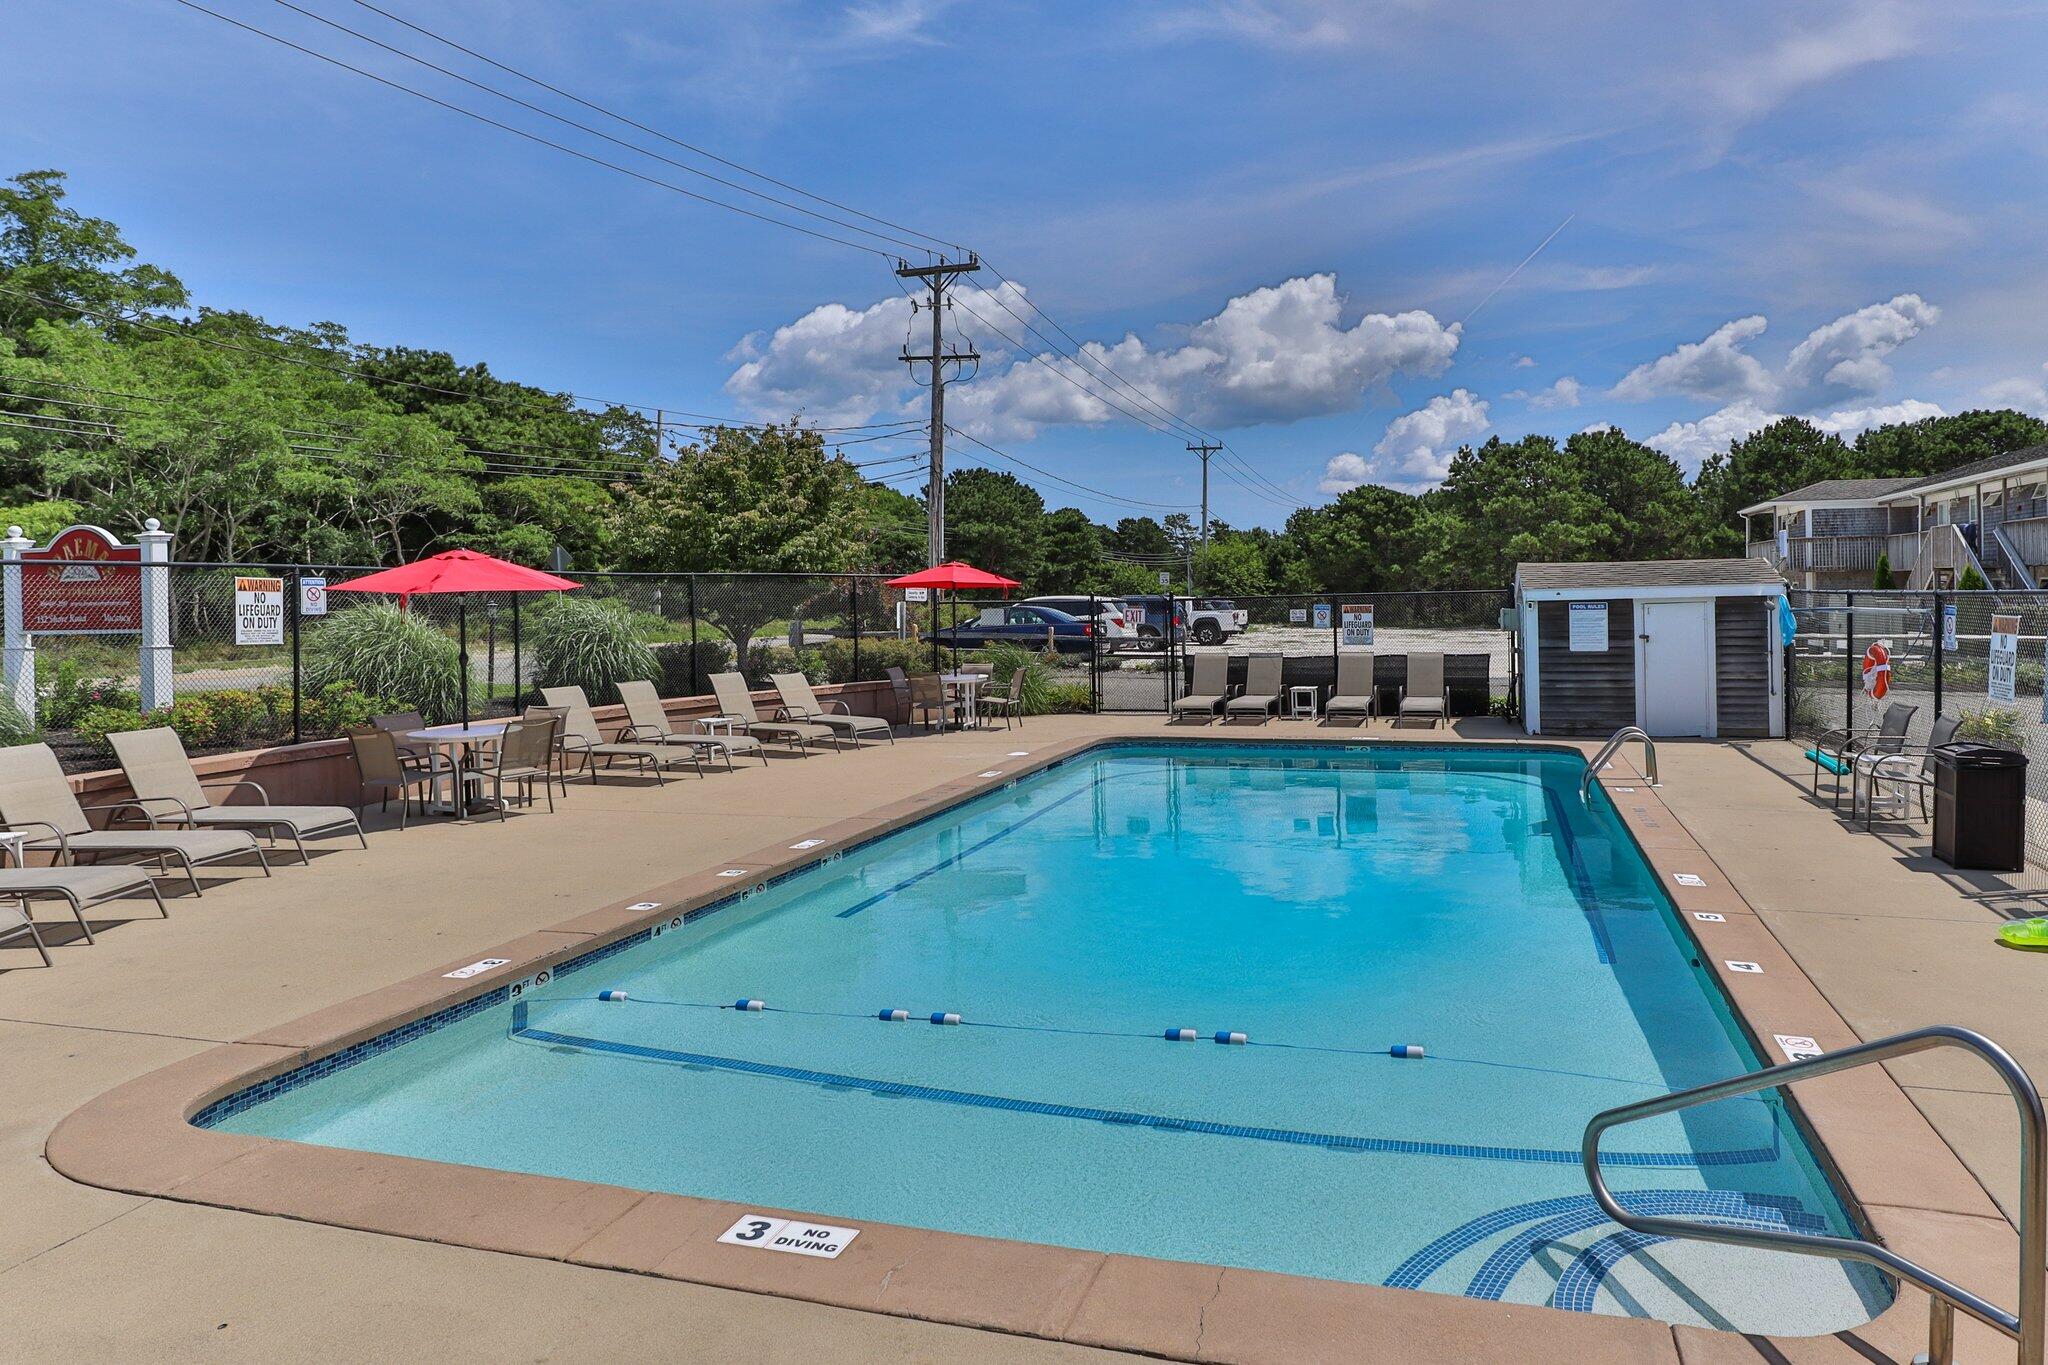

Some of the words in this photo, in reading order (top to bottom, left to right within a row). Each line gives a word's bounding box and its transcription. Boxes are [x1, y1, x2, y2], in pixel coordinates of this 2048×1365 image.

[247, 579, 280, 591] WARNING
[254, 593, 266, 604] NO
[239, 604, 280, 616] LIFEGUARD
[1126, 610, 1142, 622] EXIT
[243, 617, 254, 629] ON
[258, 617, 277, 628] DUTY
[2000, 635, 2007, 649] NO
[654, 927, 661, 937] 4
[522, 979, 530, 988] FT
[736, 1221, 772, 1240] 3
[803, 1229, 830, 1238] NO
[775, 1237, 838, 1252] DIVING
